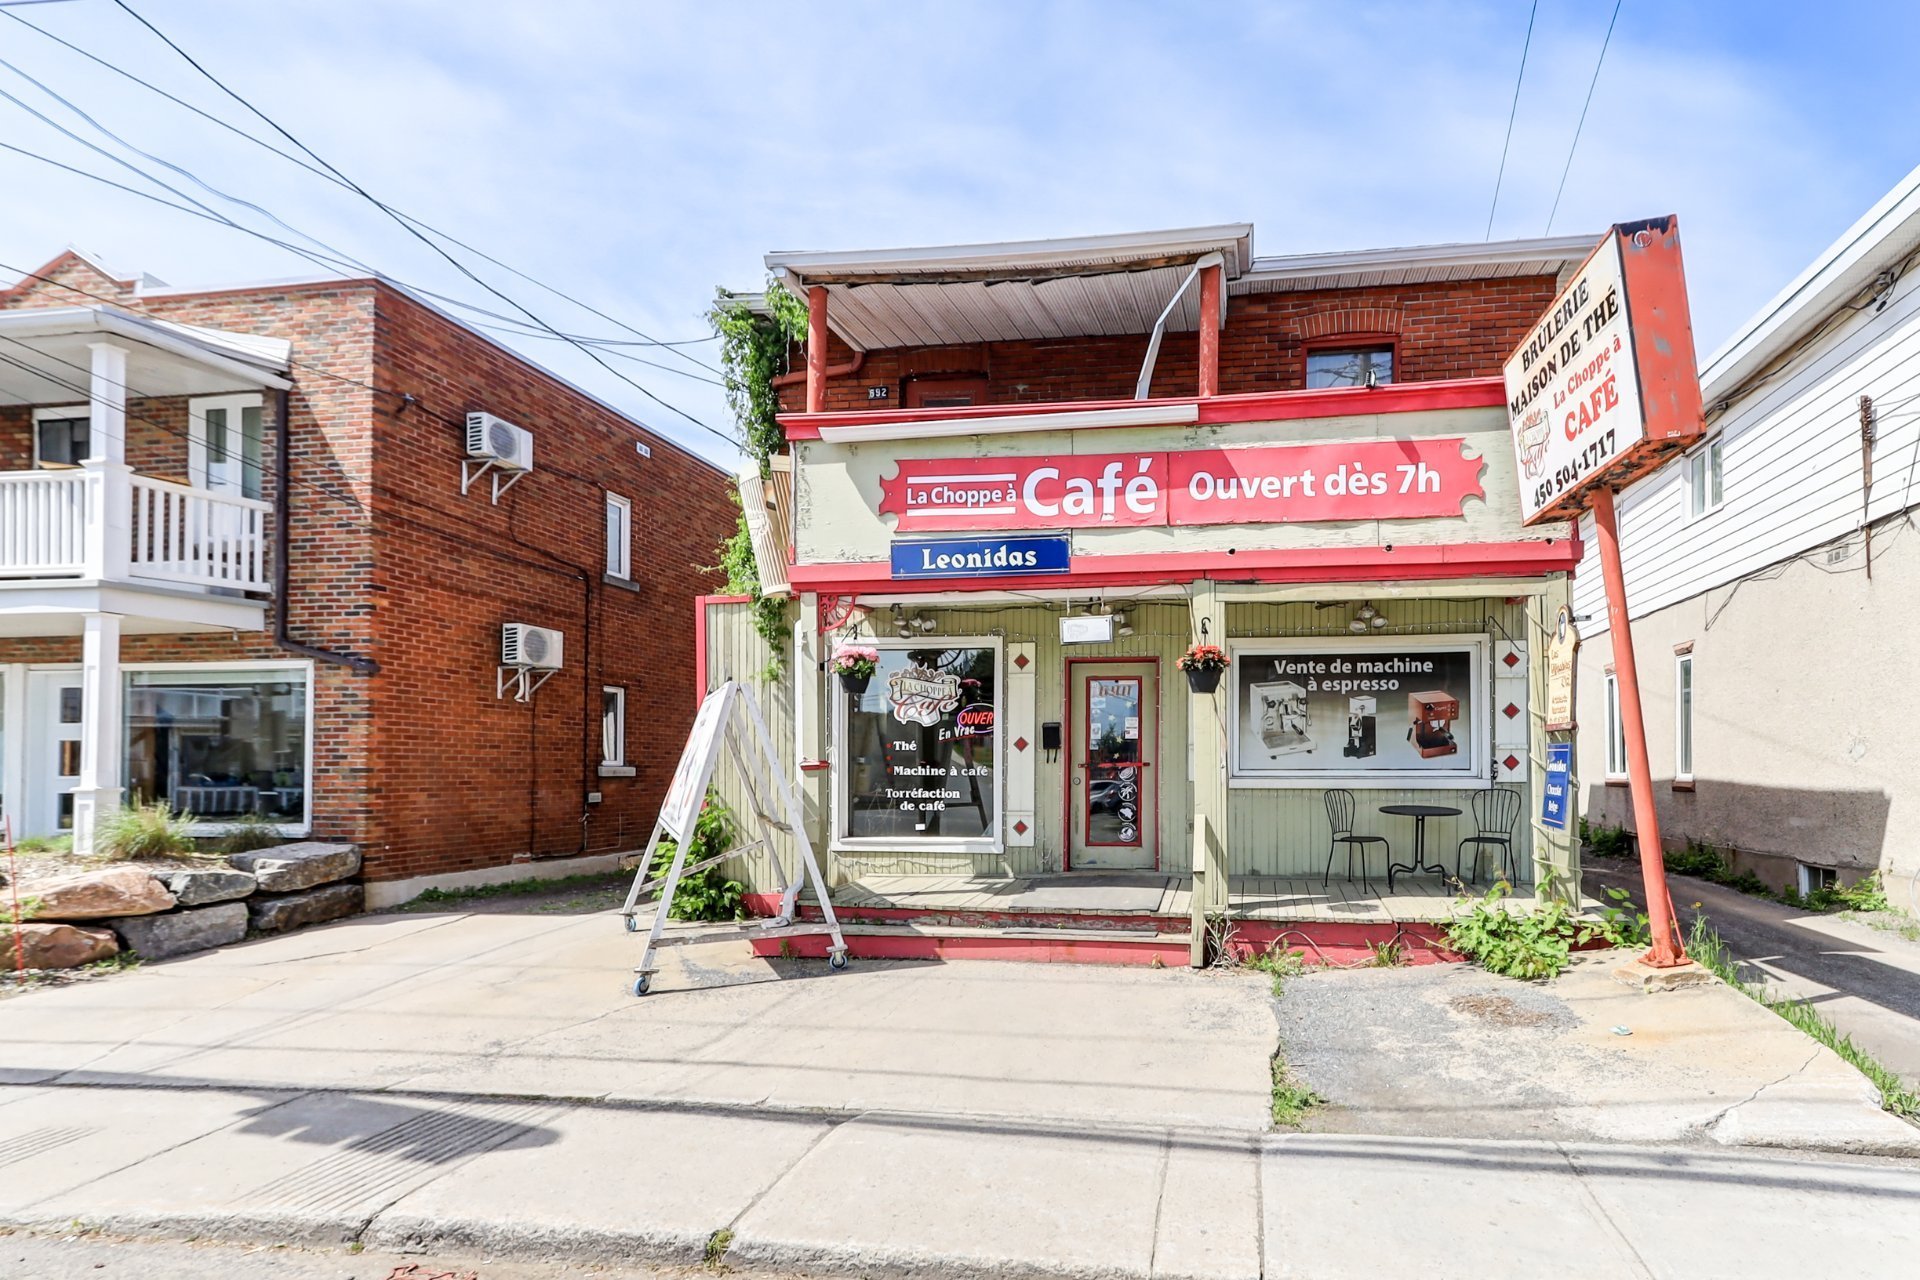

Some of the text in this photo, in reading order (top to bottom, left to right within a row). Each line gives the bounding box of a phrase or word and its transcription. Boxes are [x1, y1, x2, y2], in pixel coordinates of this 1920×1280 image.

[1522, 277, 1590, 373] BRÛLERIE
[1510, 356, 1558, 421] MAISON
[1560, 331, 1581, 369] DE
[1584, 284, 1620, 334] THÉ
[1553, 333, 1622, 410] La Choppe à
[1564, 368, 1620, 442] CAFÉ
[1534, 477, 1553, 509] 450
[1555, 428, 1616, 493] 504-1717
[906, 457, 1159, 521] La Choppe à Café
[1188, 461, 1441, 501] Ouvert dès 7h
[922, 545, 1038, 570] Leonidas
[1274, 658, 1434, 675] Vente de machine
[903, 682, 913, 691] LA
[914, 683, 947, 697] CHOPPE
[1307, 677, 1400, 694] à espresso
[938, 725, 975, 741] En Vrac
[893, 741, 917, 751] Thé
[893, 765, 988, 776] Machine à café
[885, 788, 961, 799] Torréfaction
[900, 800, 945, 811] de café
